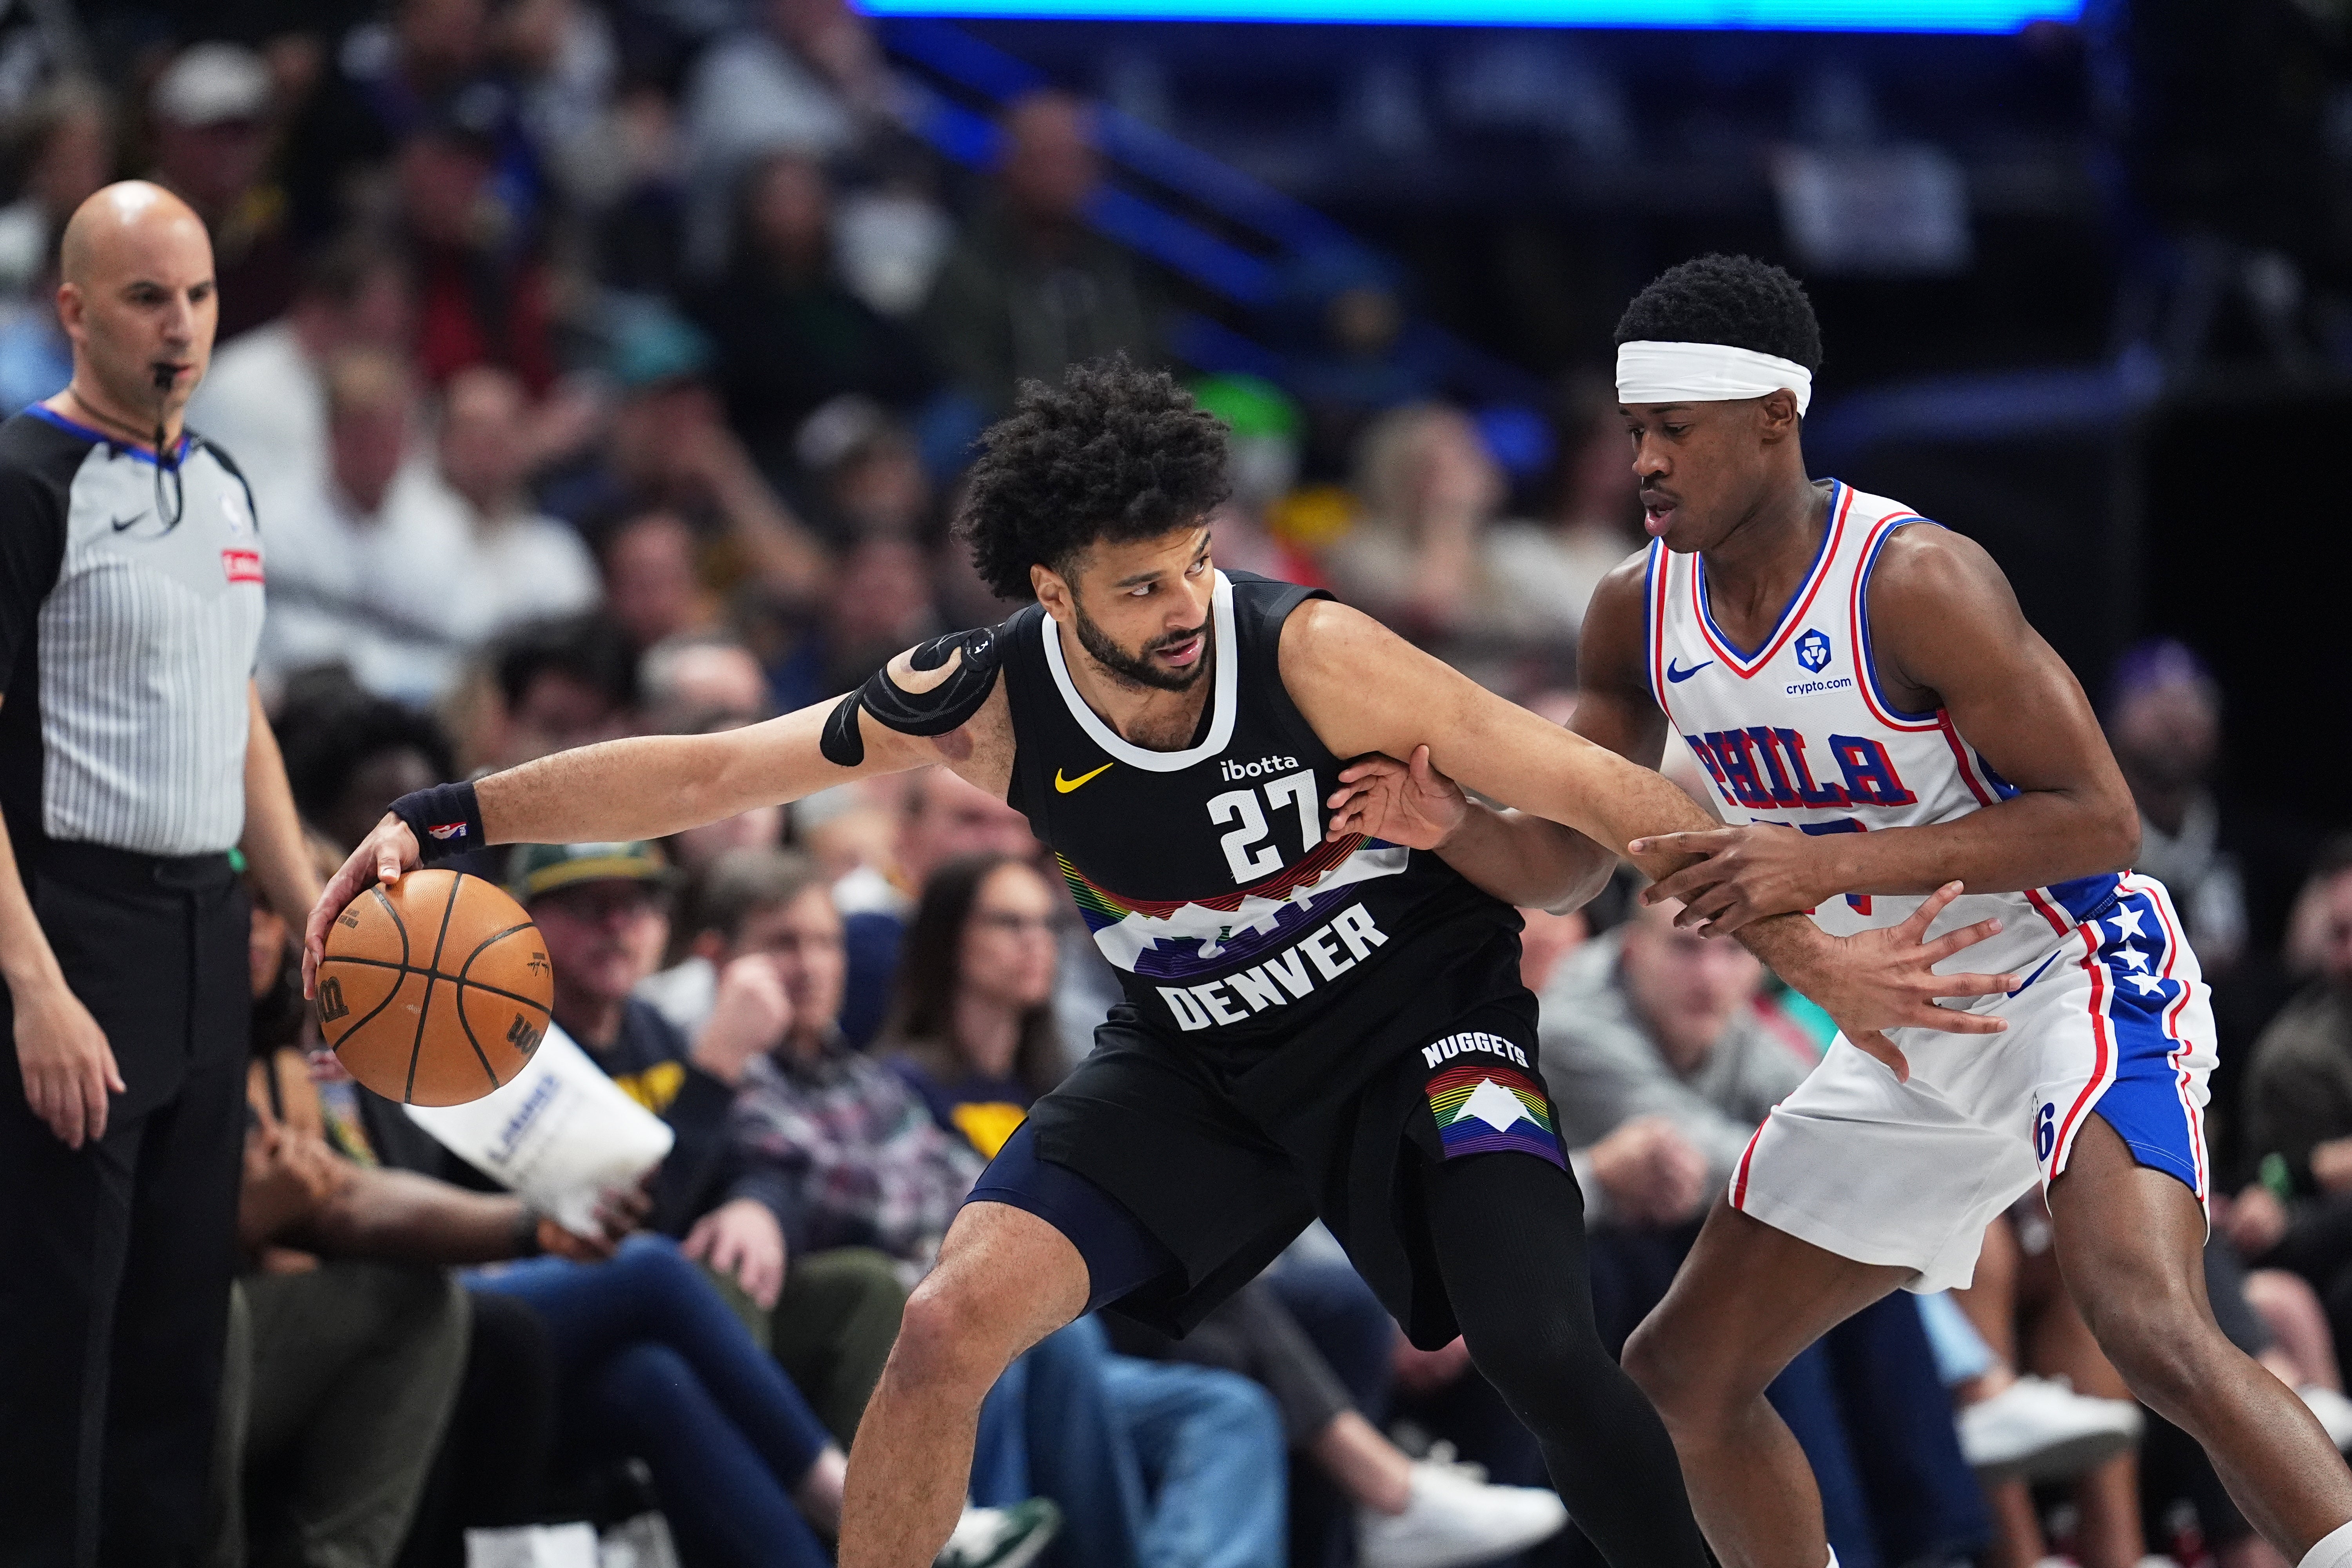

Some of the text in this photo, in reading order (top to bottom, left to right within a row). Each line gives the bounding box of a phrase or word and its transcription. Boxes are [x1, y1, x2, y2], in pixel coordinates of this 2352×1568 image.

[1786, 678, 1851, 694] crypto.com
[1220, 755, 1299, 781] ibotta
[1683, 726, 1918, 809] PHILA
[1207, 769, 1321, 884] 27
[1155, 902, 1389, 1031] DENVER
[1421, 1032, 1529, 1069] NUGGETS
[2033, 1102, 2055, 1162] 6
